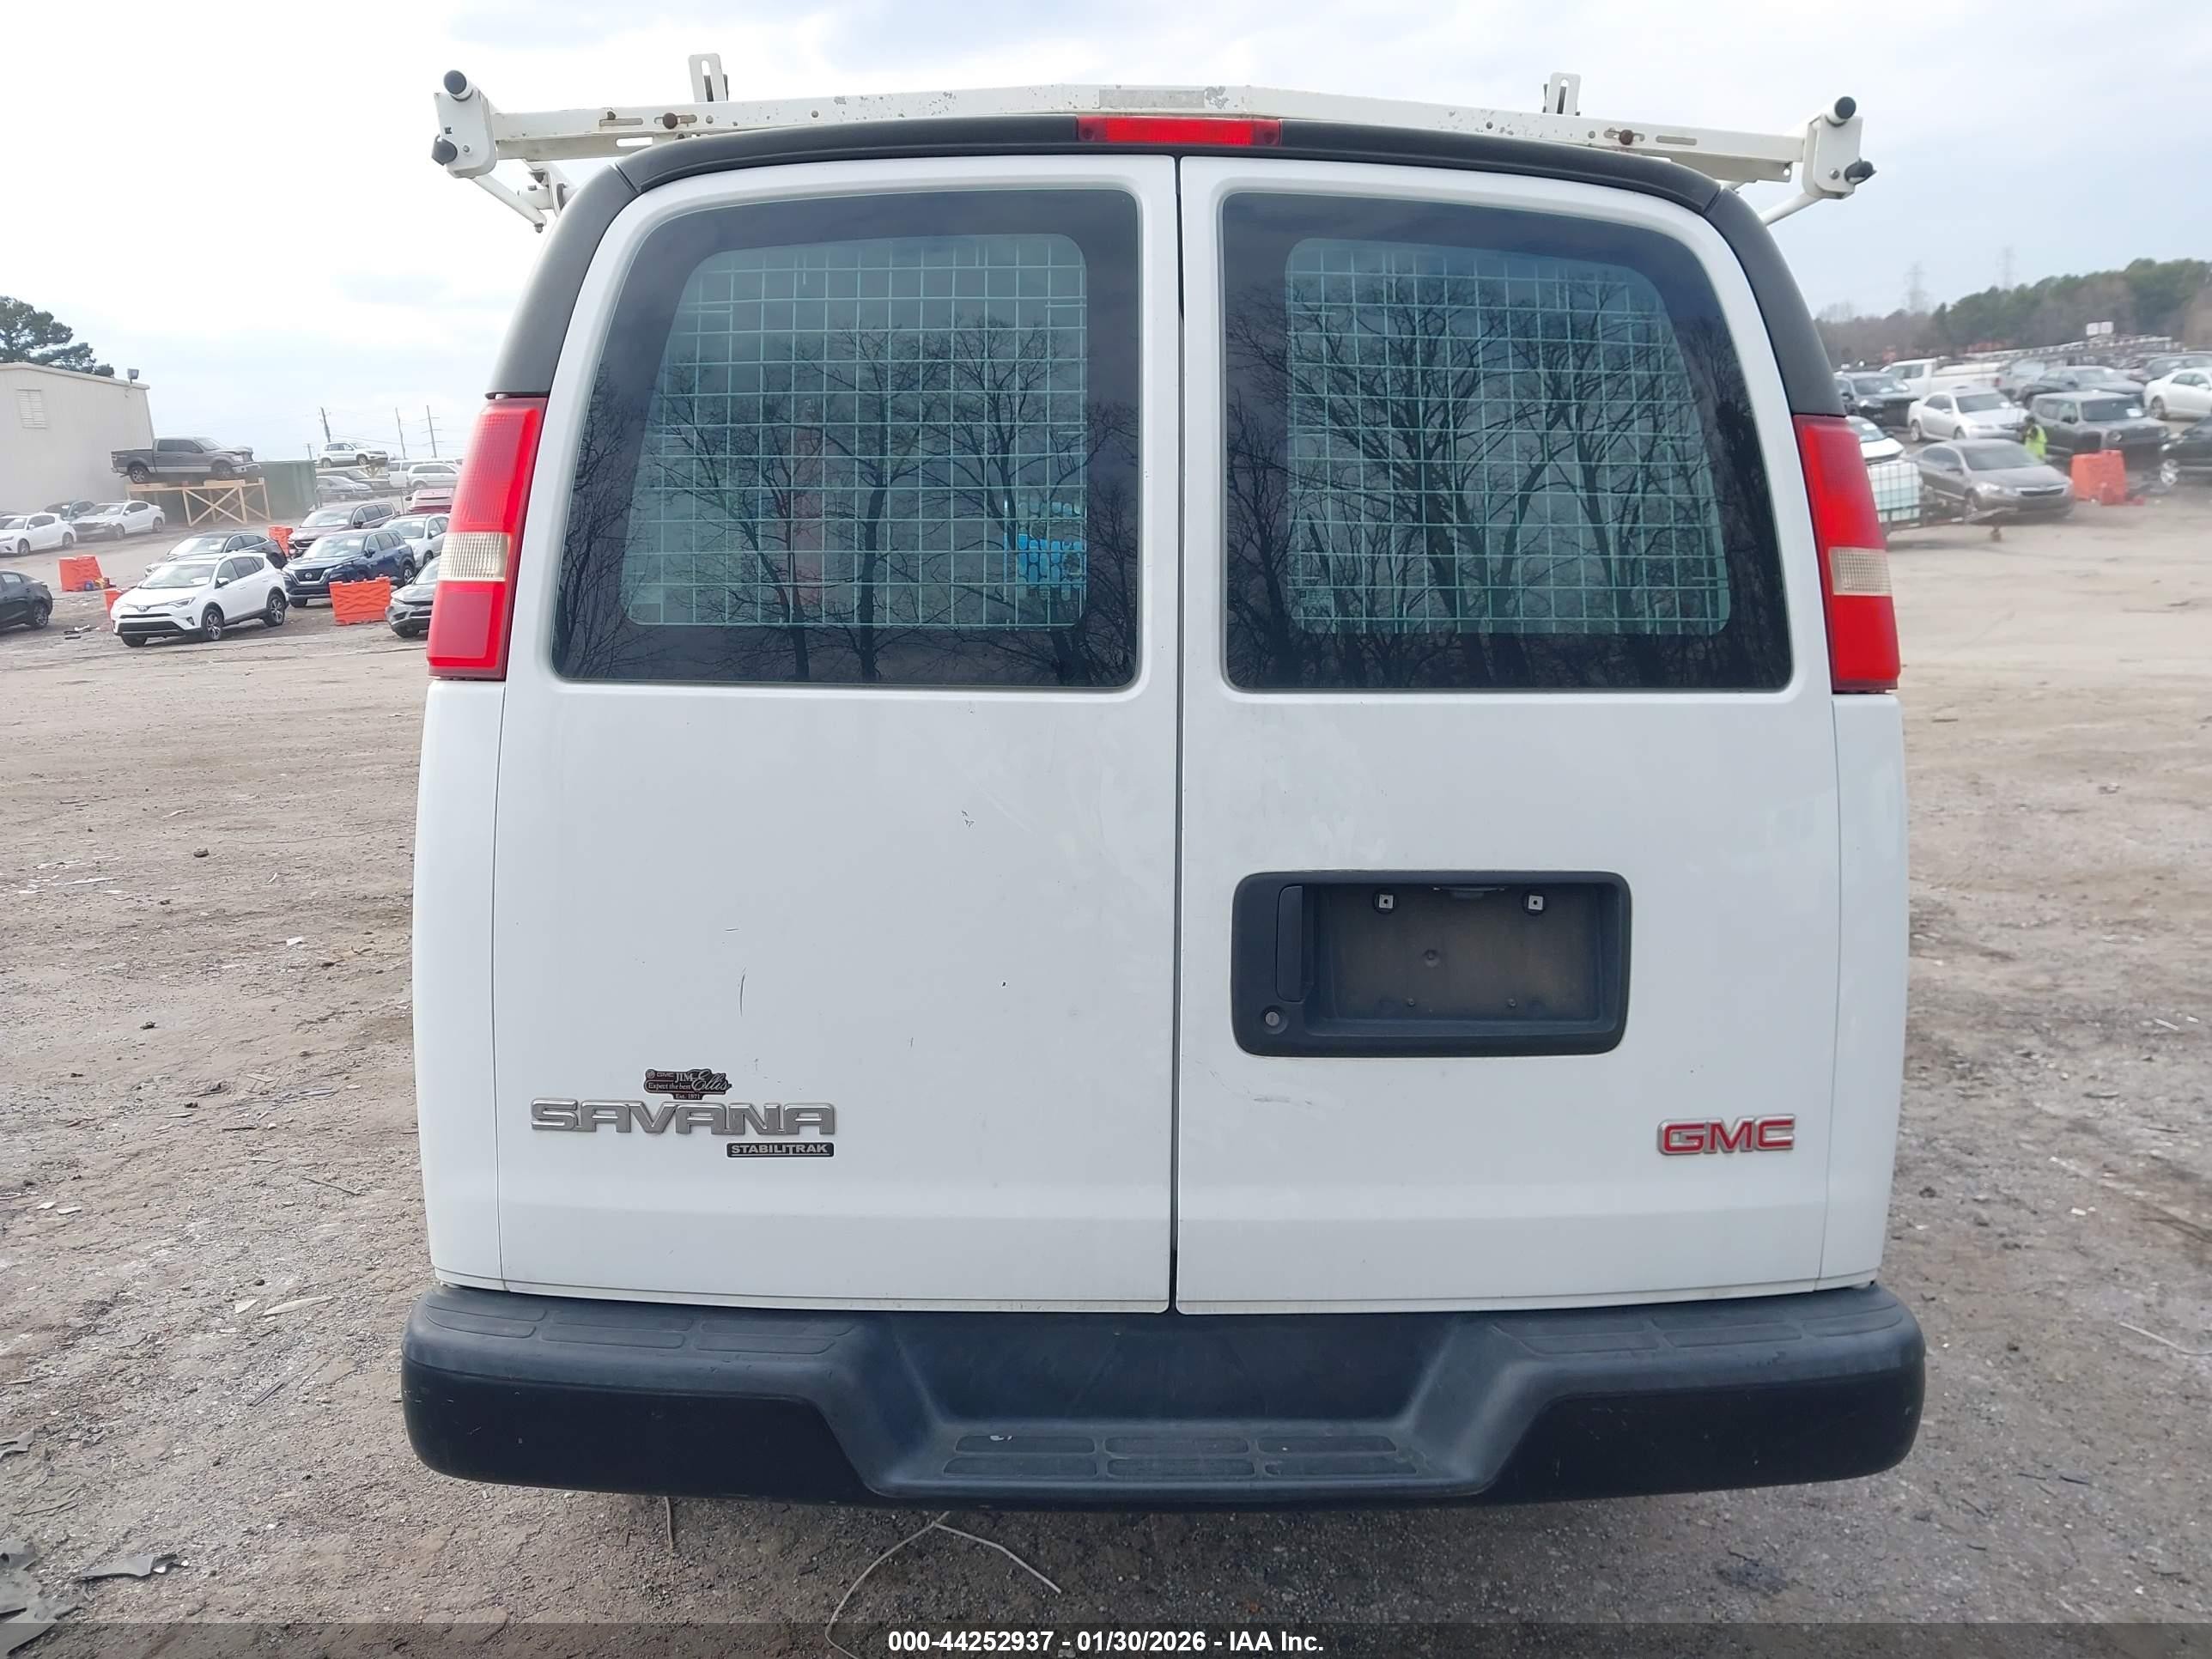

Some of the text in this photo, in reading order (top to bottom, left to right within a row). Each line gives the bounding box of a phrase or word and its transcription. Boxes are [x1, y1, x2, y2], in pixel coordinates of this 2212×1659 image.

[648, 1082, 668, 1091] Expect
[675, 1069, 729, 1091] JIM Ellis
[531, 1098, 836, 1135] SAVANA
[1657, 1114, 1795, 1156] GMC
[731, 1144, 828, 1155] STABILITRAK
